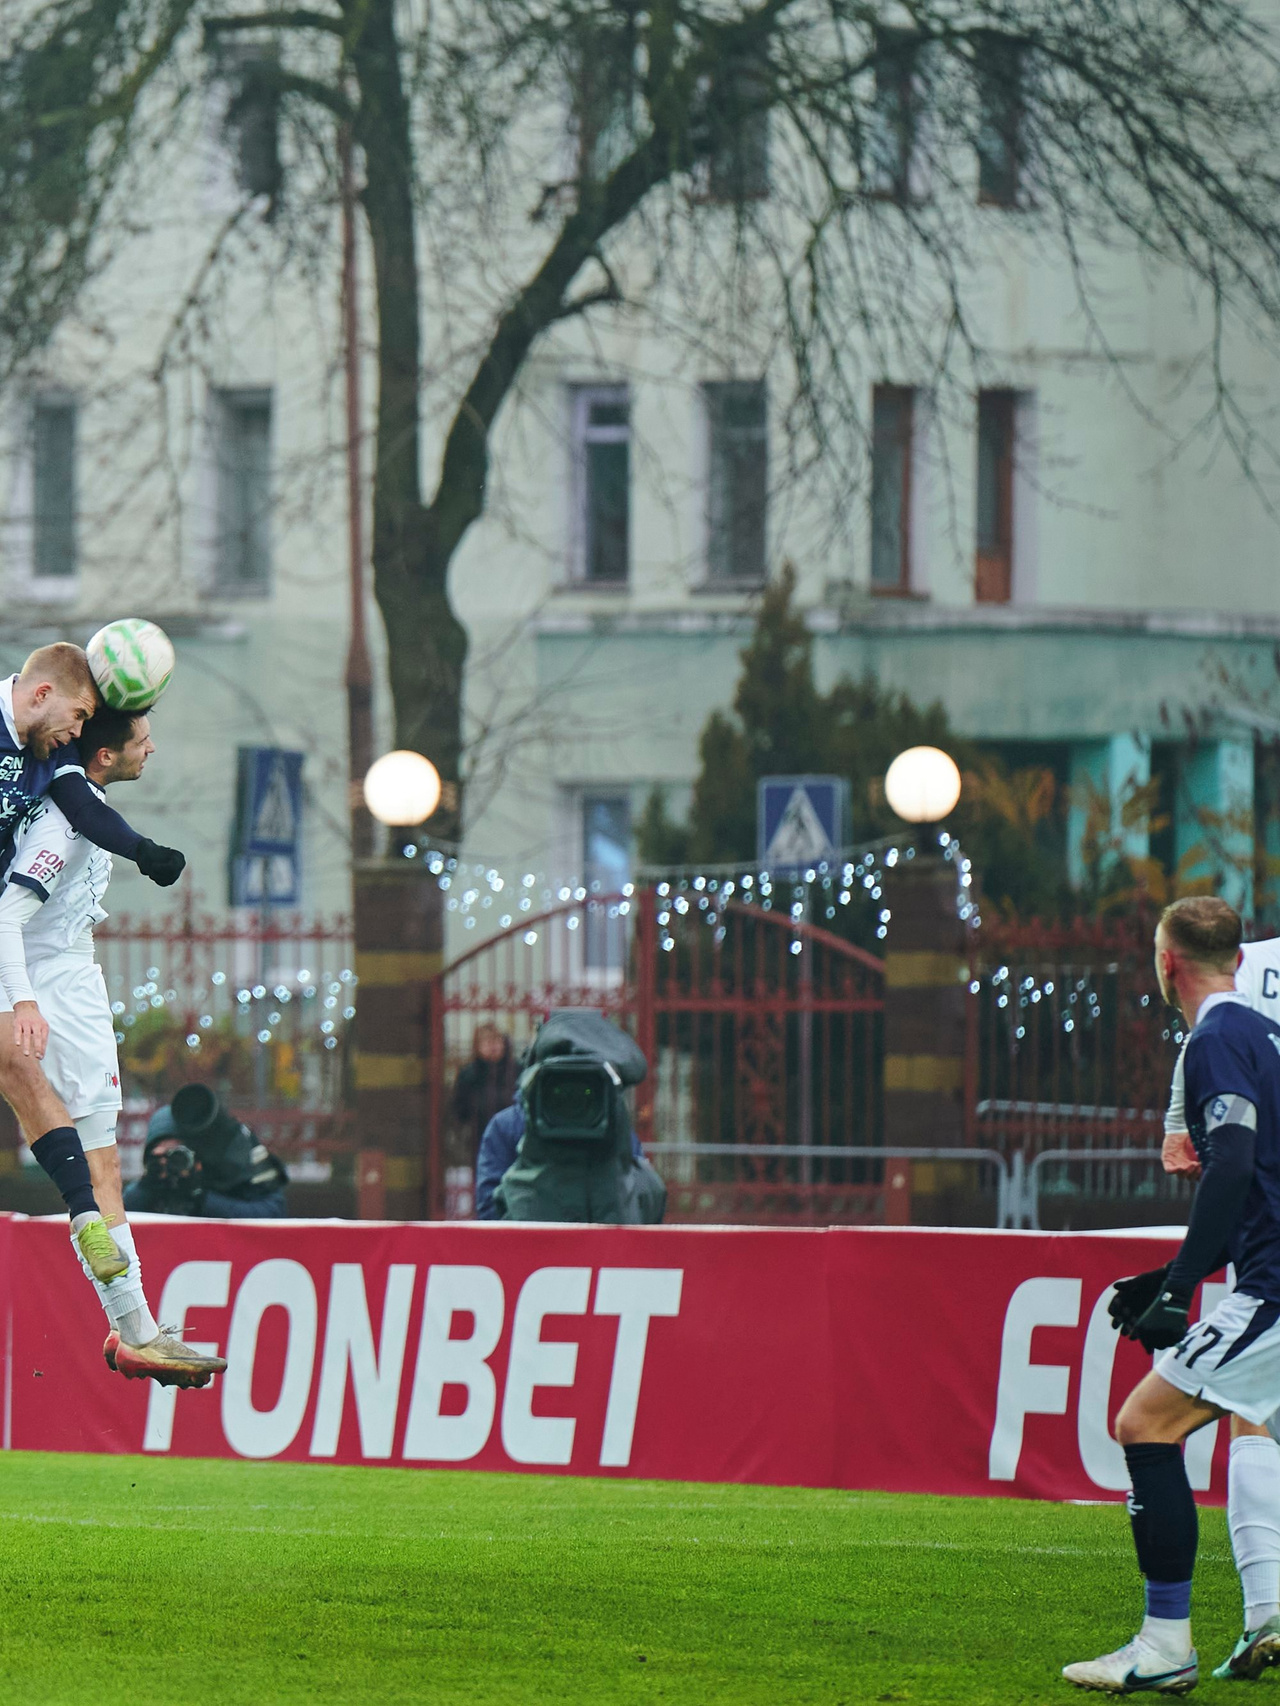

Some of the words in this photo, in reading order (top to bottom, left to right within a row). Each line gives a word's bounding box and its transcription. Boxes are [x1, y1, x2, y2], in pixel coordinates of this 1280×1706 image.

[27, 862, 56, 884] BET
[35, 849, 67, 874] FON
[143, 1258, 684, 1467] FONBET
